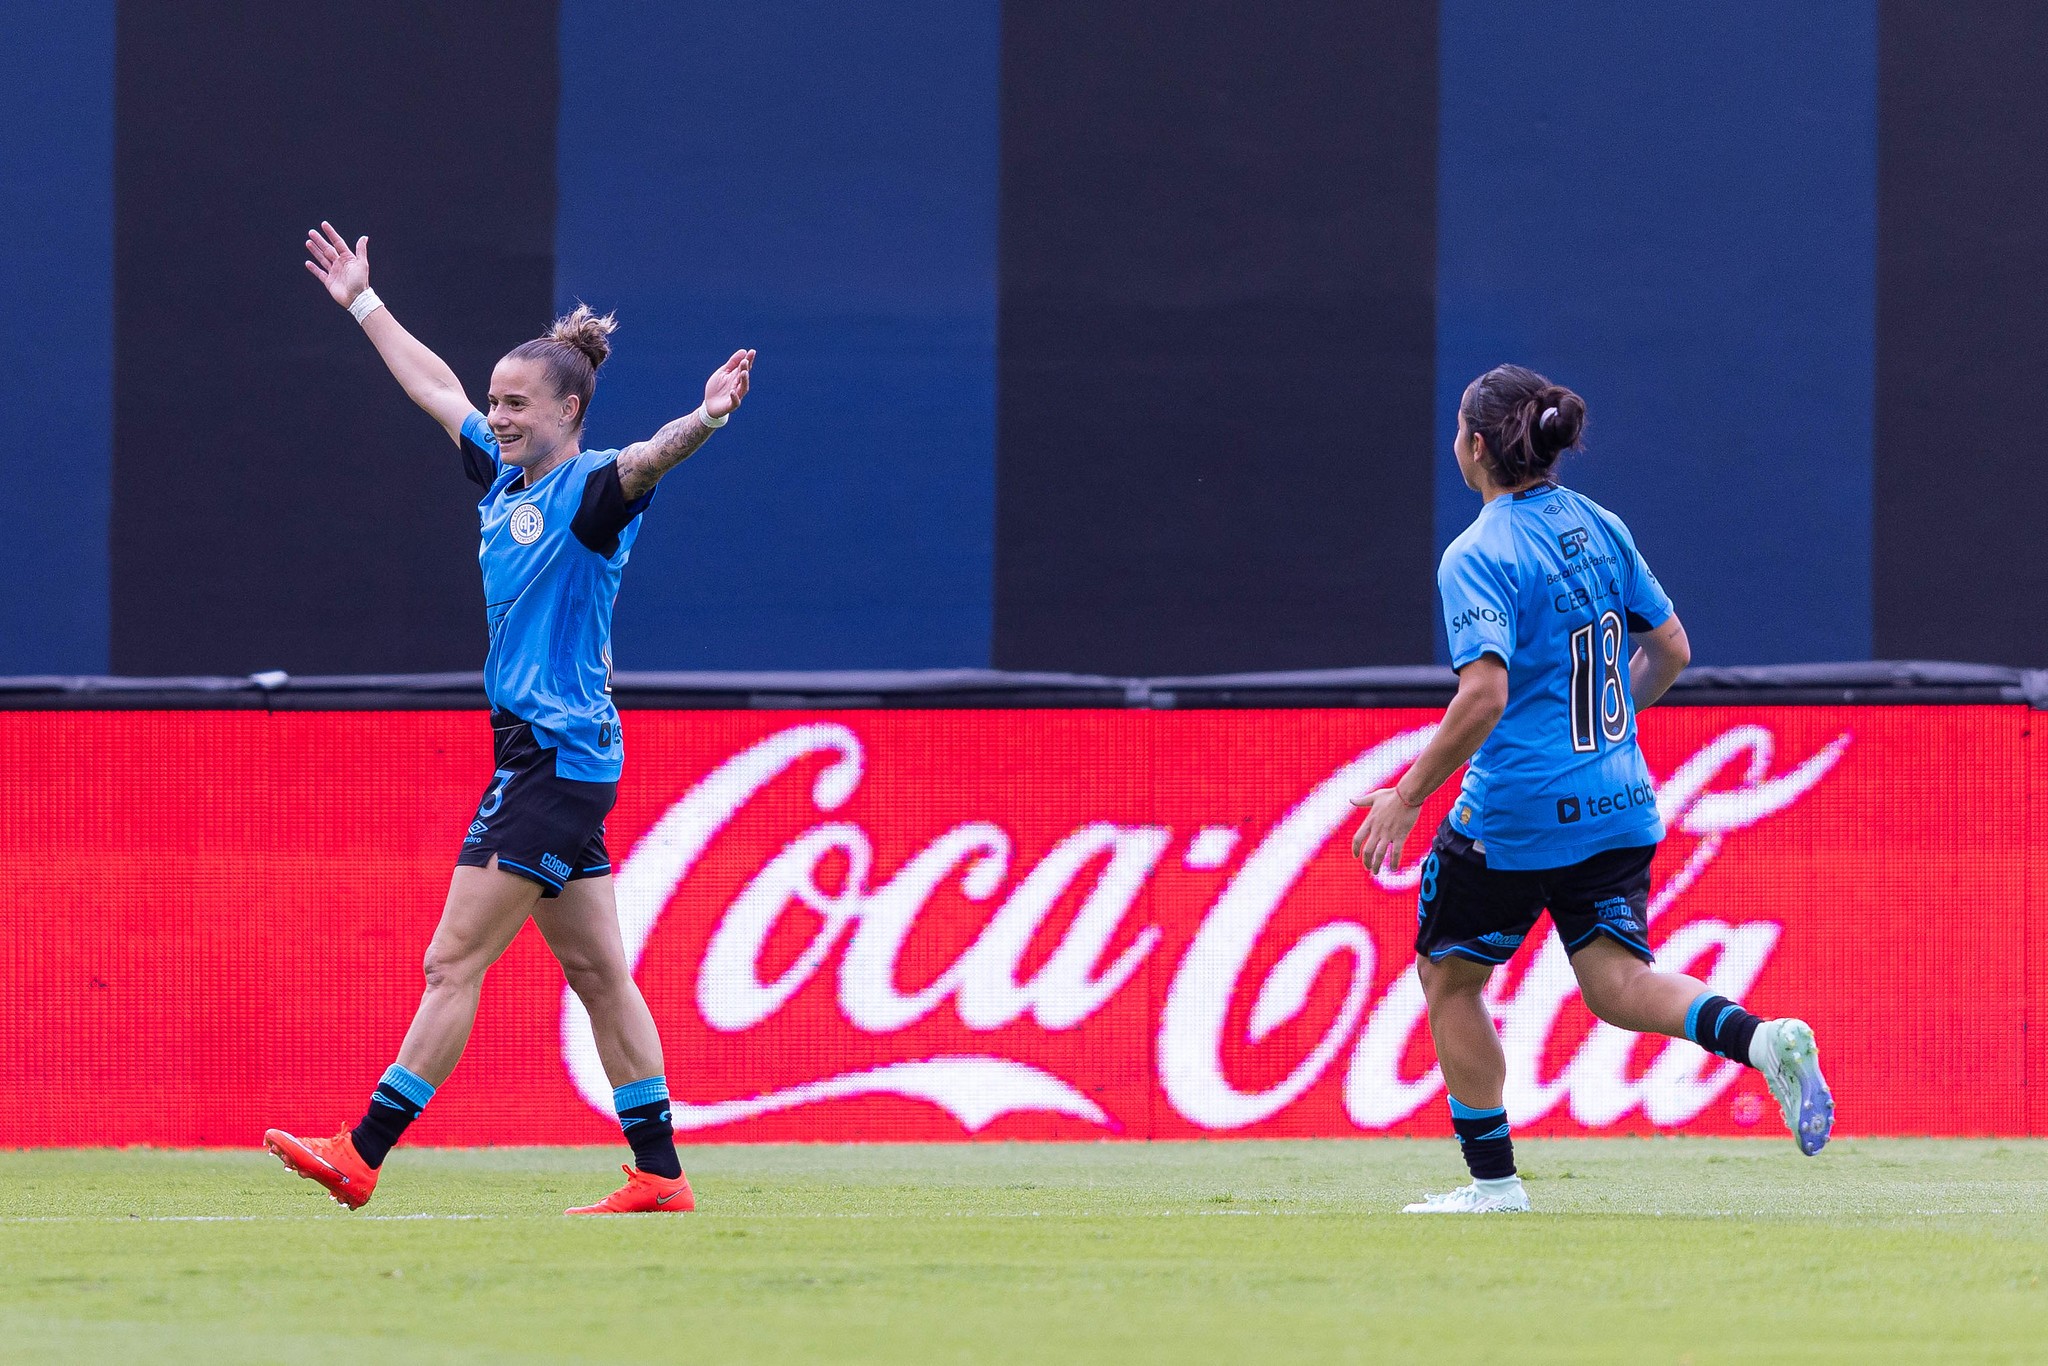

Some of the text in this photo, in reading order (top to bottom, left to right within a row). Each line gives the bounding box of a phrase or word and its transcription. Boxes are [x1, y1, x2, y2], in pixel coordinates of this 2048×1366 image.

[1452, 606, 1507, 634] SANOS
[1569, 610, 1628, 754] 18
[1586, 778, 1654, 817] teclab
